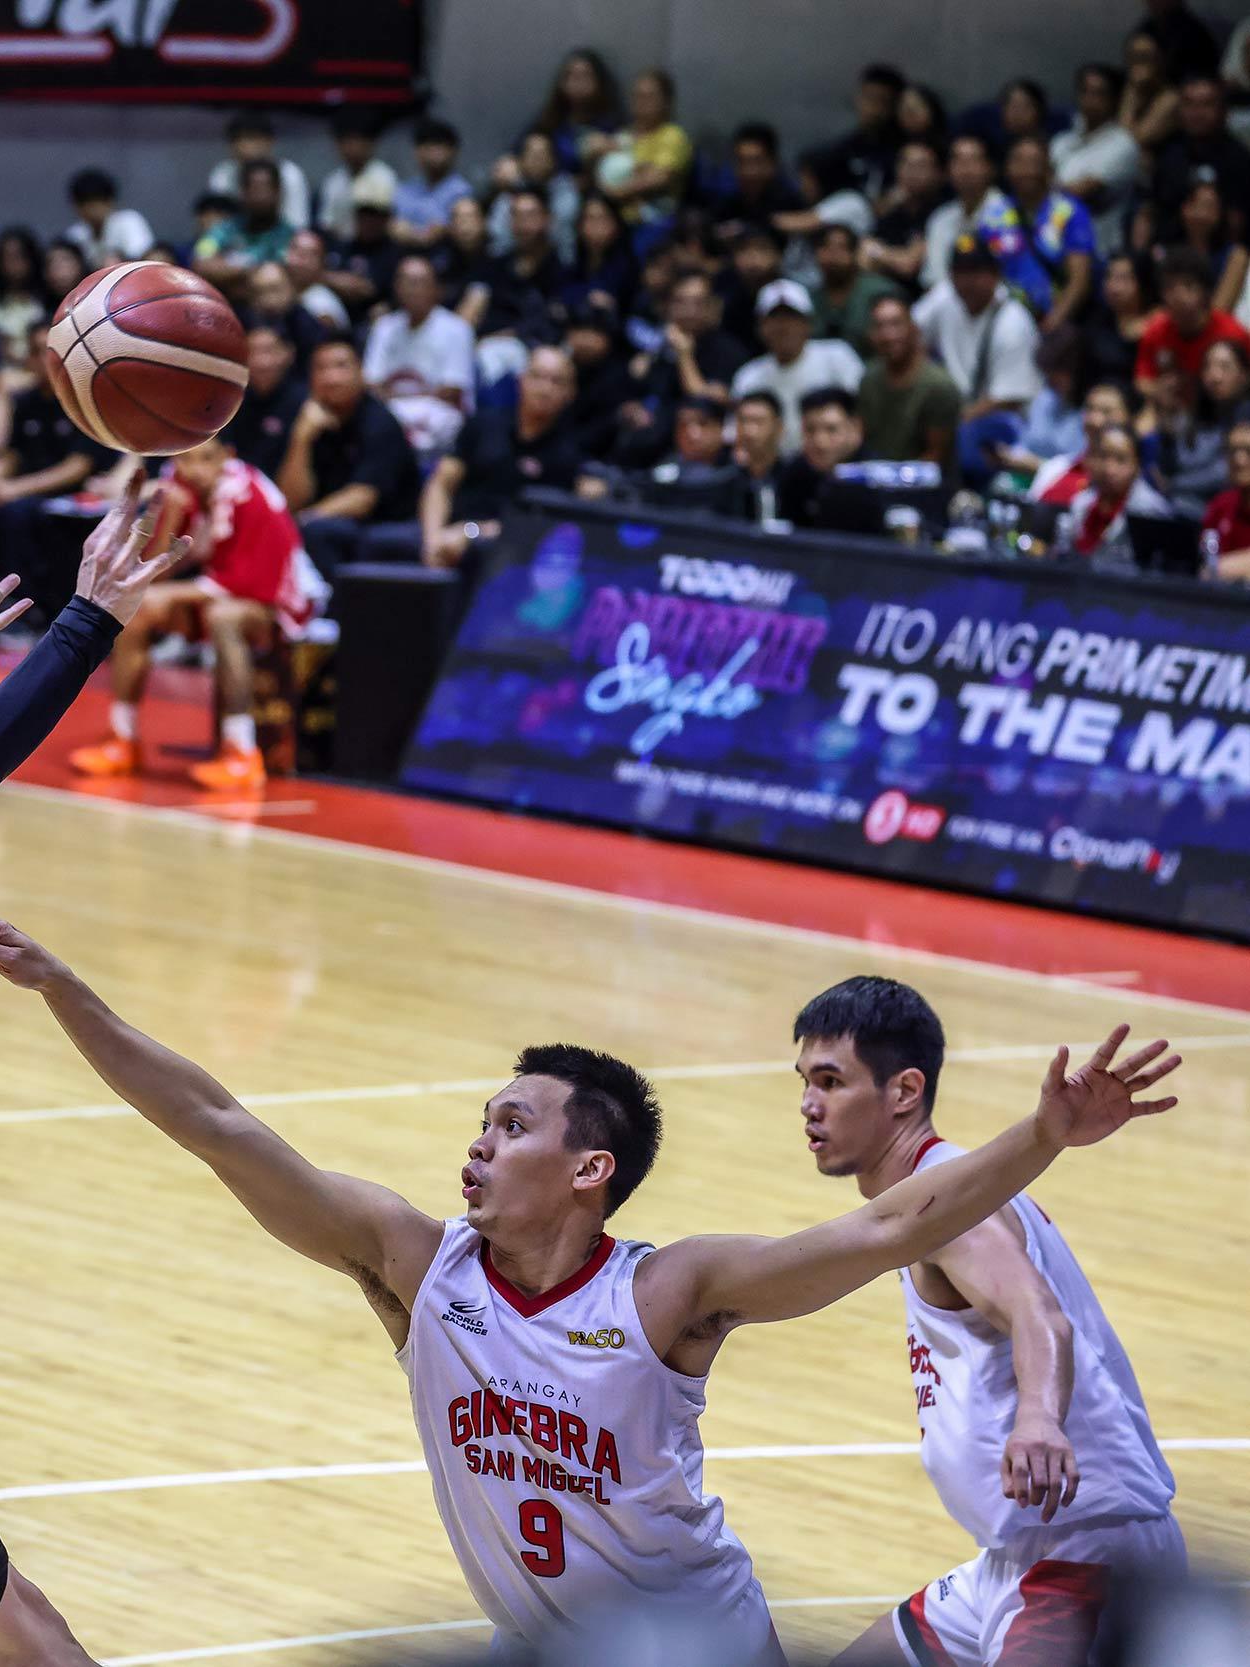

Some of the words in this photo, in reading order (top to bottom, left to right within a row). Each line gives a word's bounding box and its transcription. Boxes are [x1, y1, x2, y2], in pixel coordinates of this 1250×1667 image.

[855, 602, 938, 665] ITO
[934, 616, 1040, 679] ANG
[837, 663, 939, 736] TO
[957, 682, 1122, 765] THE
[441, 1313, 488, 1336] BALANCE
[448, 1309, 484, 1328] WORLD
[487, 1375, 582, 1408] ARANGAY
[448, 1387, 622, 1485] GINEBRA
[464, 1444, 516, 1482] SAN
[522, 1456, 611, 1506] MIGUEL
[518, 1498, 566, 1578] 9
